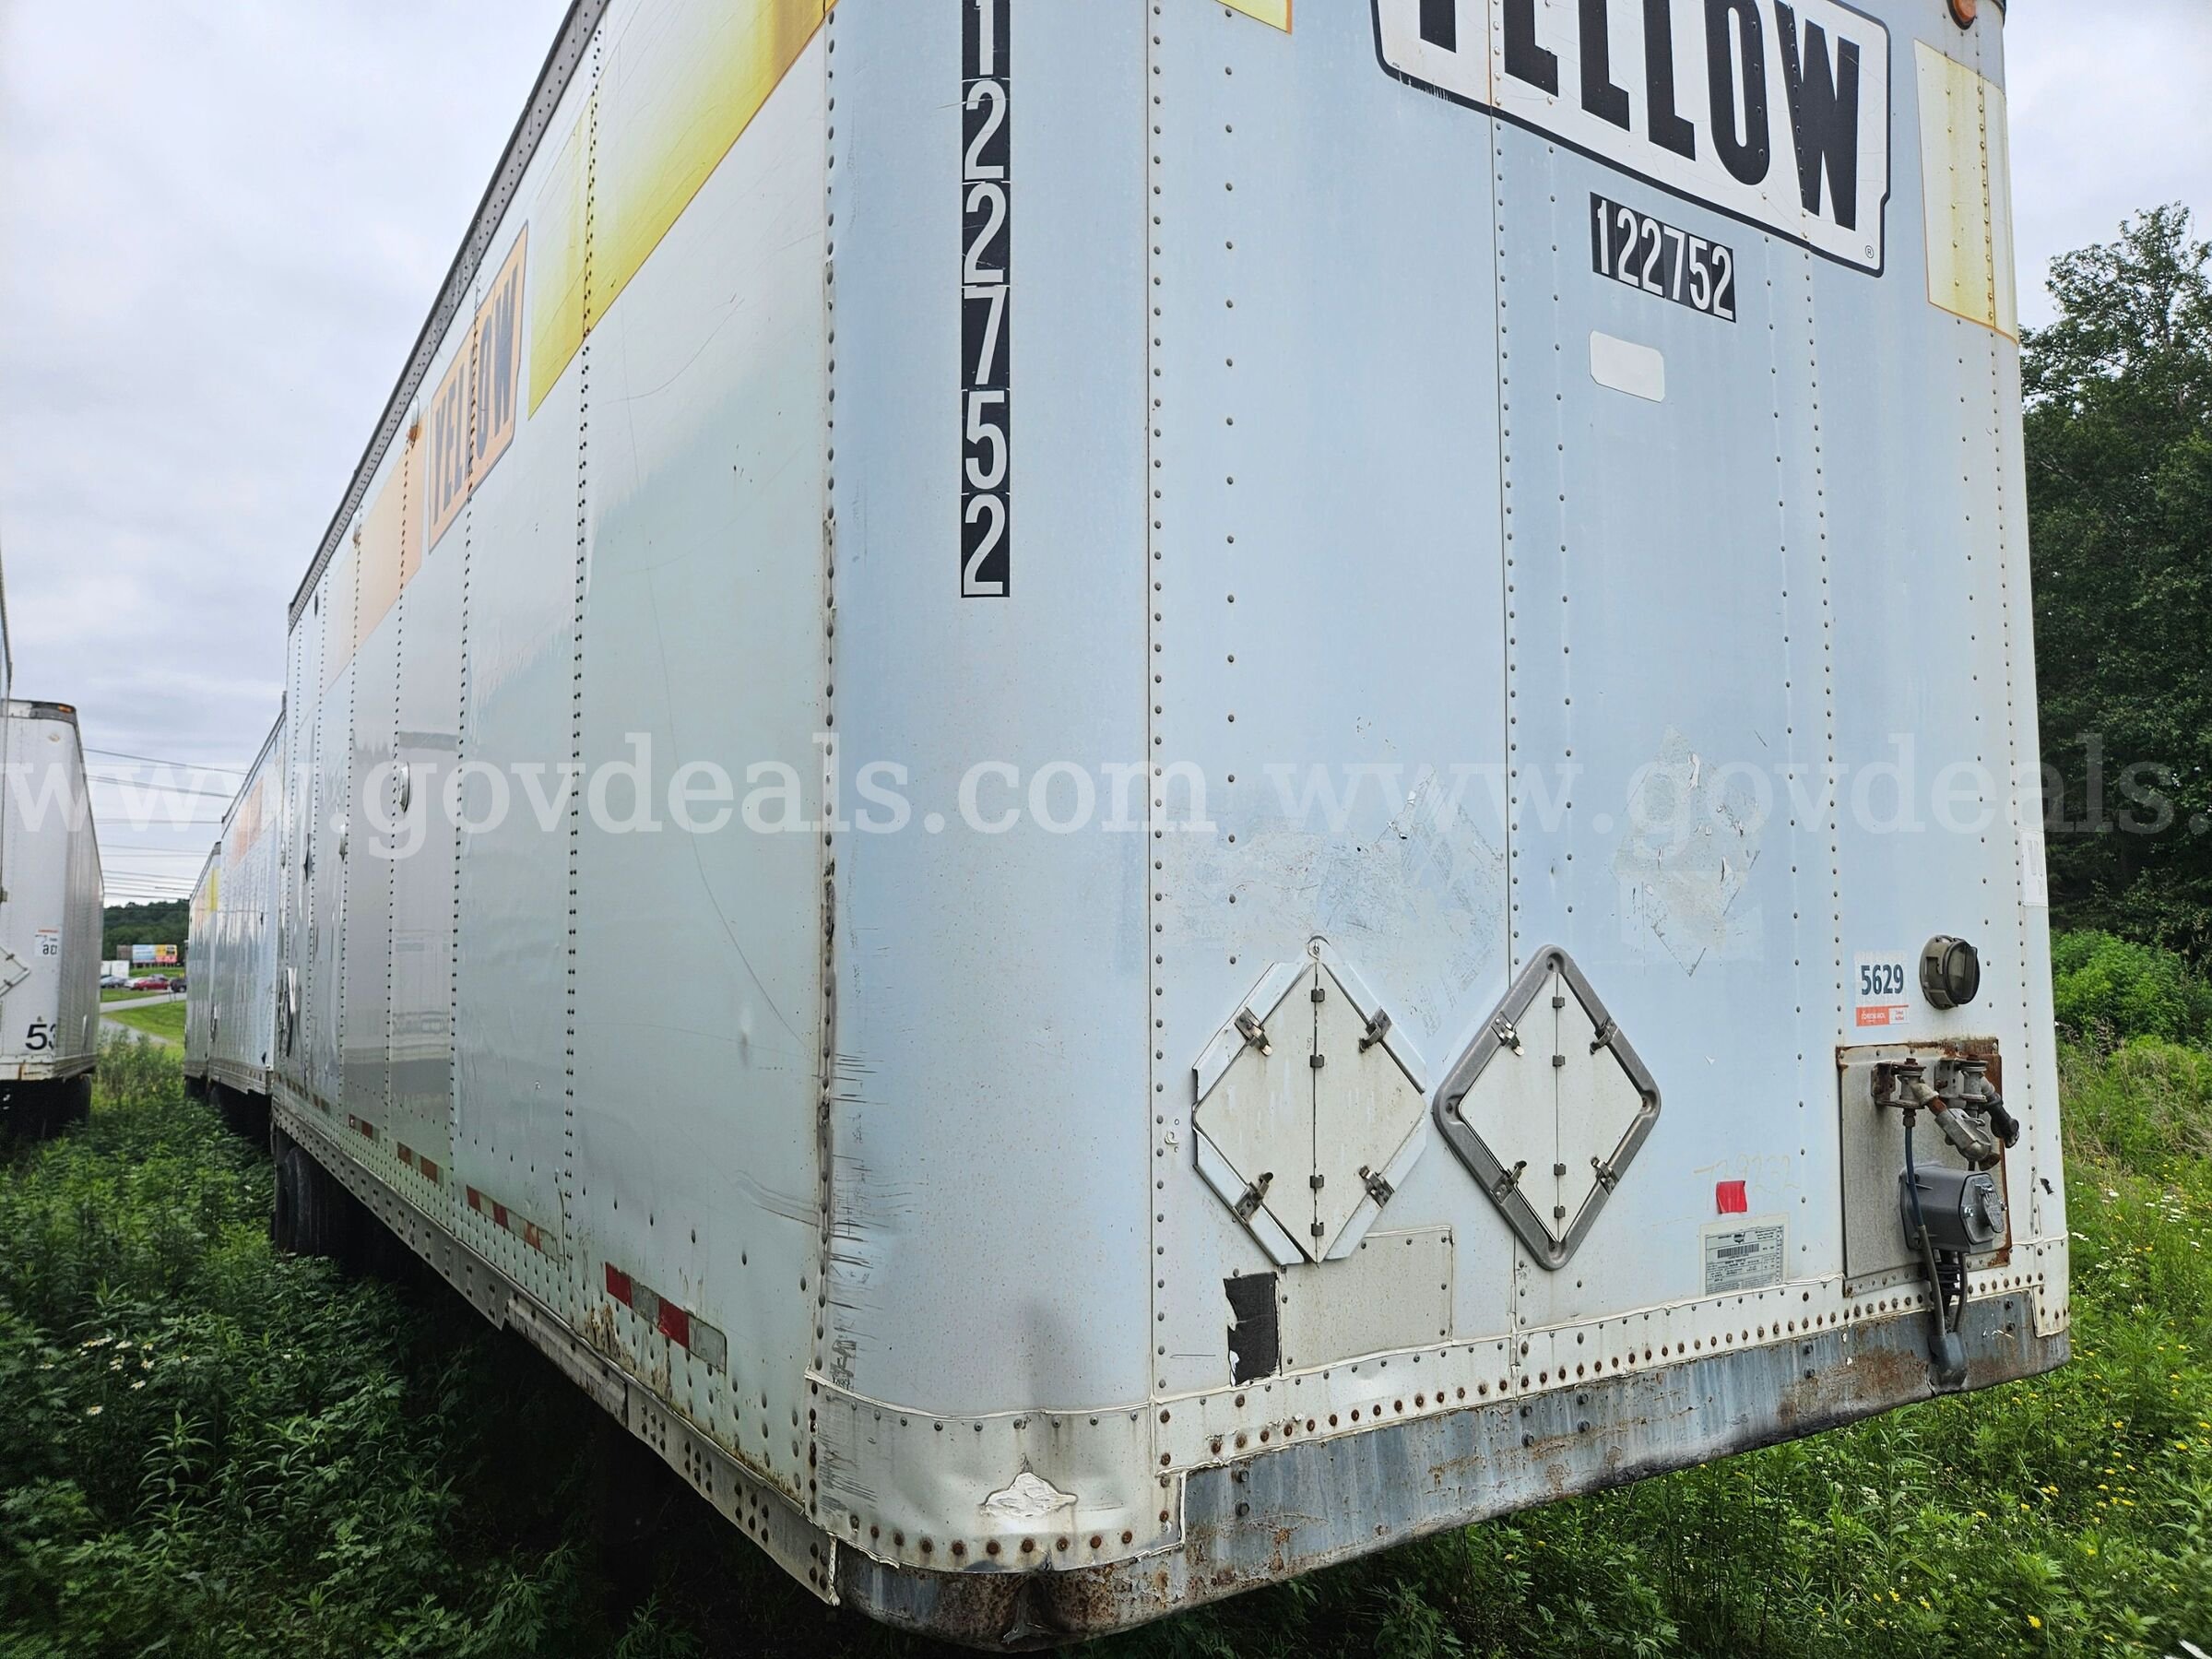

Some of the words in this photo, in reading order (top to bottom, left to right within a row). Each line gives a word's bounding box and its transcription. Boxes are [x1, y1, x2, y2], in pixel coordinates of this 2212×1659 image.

[962, 0, 1009, 597] 122752
[1596, 197, 1734, 320] 122752
[1861, 964, 1904, 995] 5629
